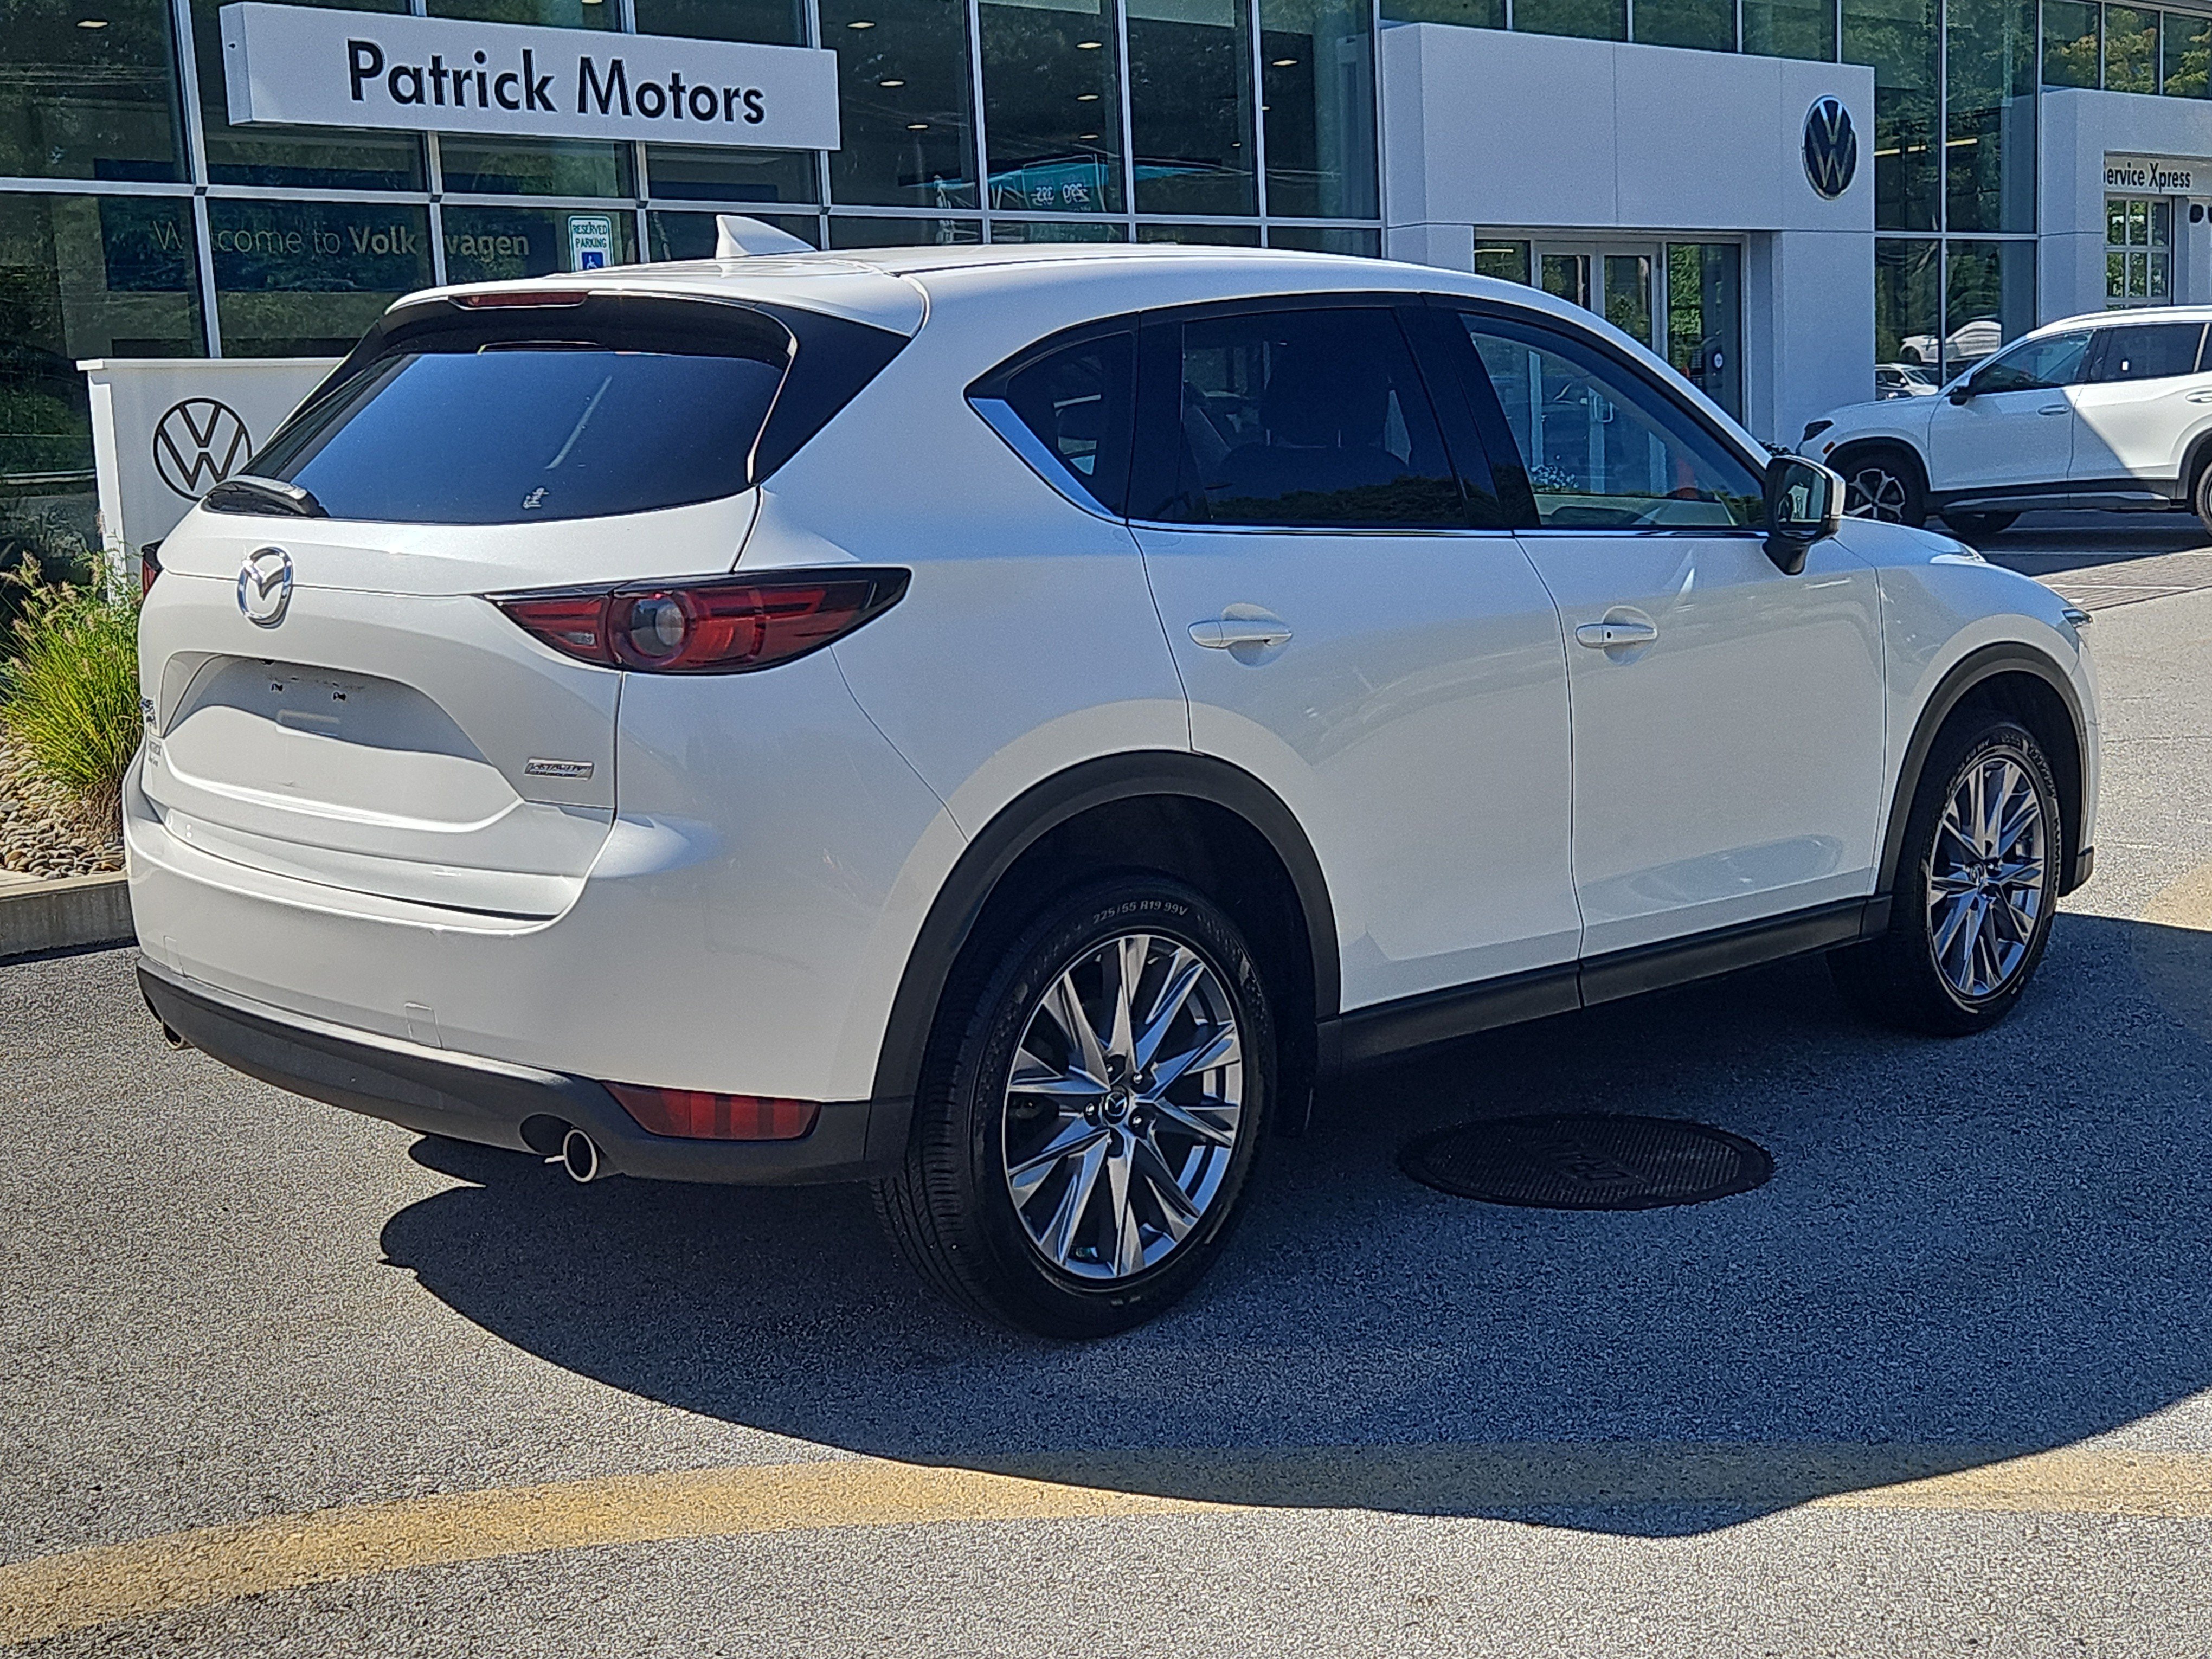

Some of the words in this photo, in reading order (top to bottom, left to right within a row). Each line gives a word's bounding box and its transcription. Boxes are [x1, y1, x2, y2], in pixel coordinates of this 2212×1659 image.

[347, 38, 558, 113] Patrick
[577, 56, 765, 125] Motors
[2104, 162, 2145, 186] ervice
[2149, 163, 2191, 194] Xpress
[153, 220, 301, 253] Wlcome
[312, 229, 340, 254] to
[575, 238, 607, 248] PARKING
[1140, 900, 1162, 910] R19
[1164, 902, 1188, 916] 99V
